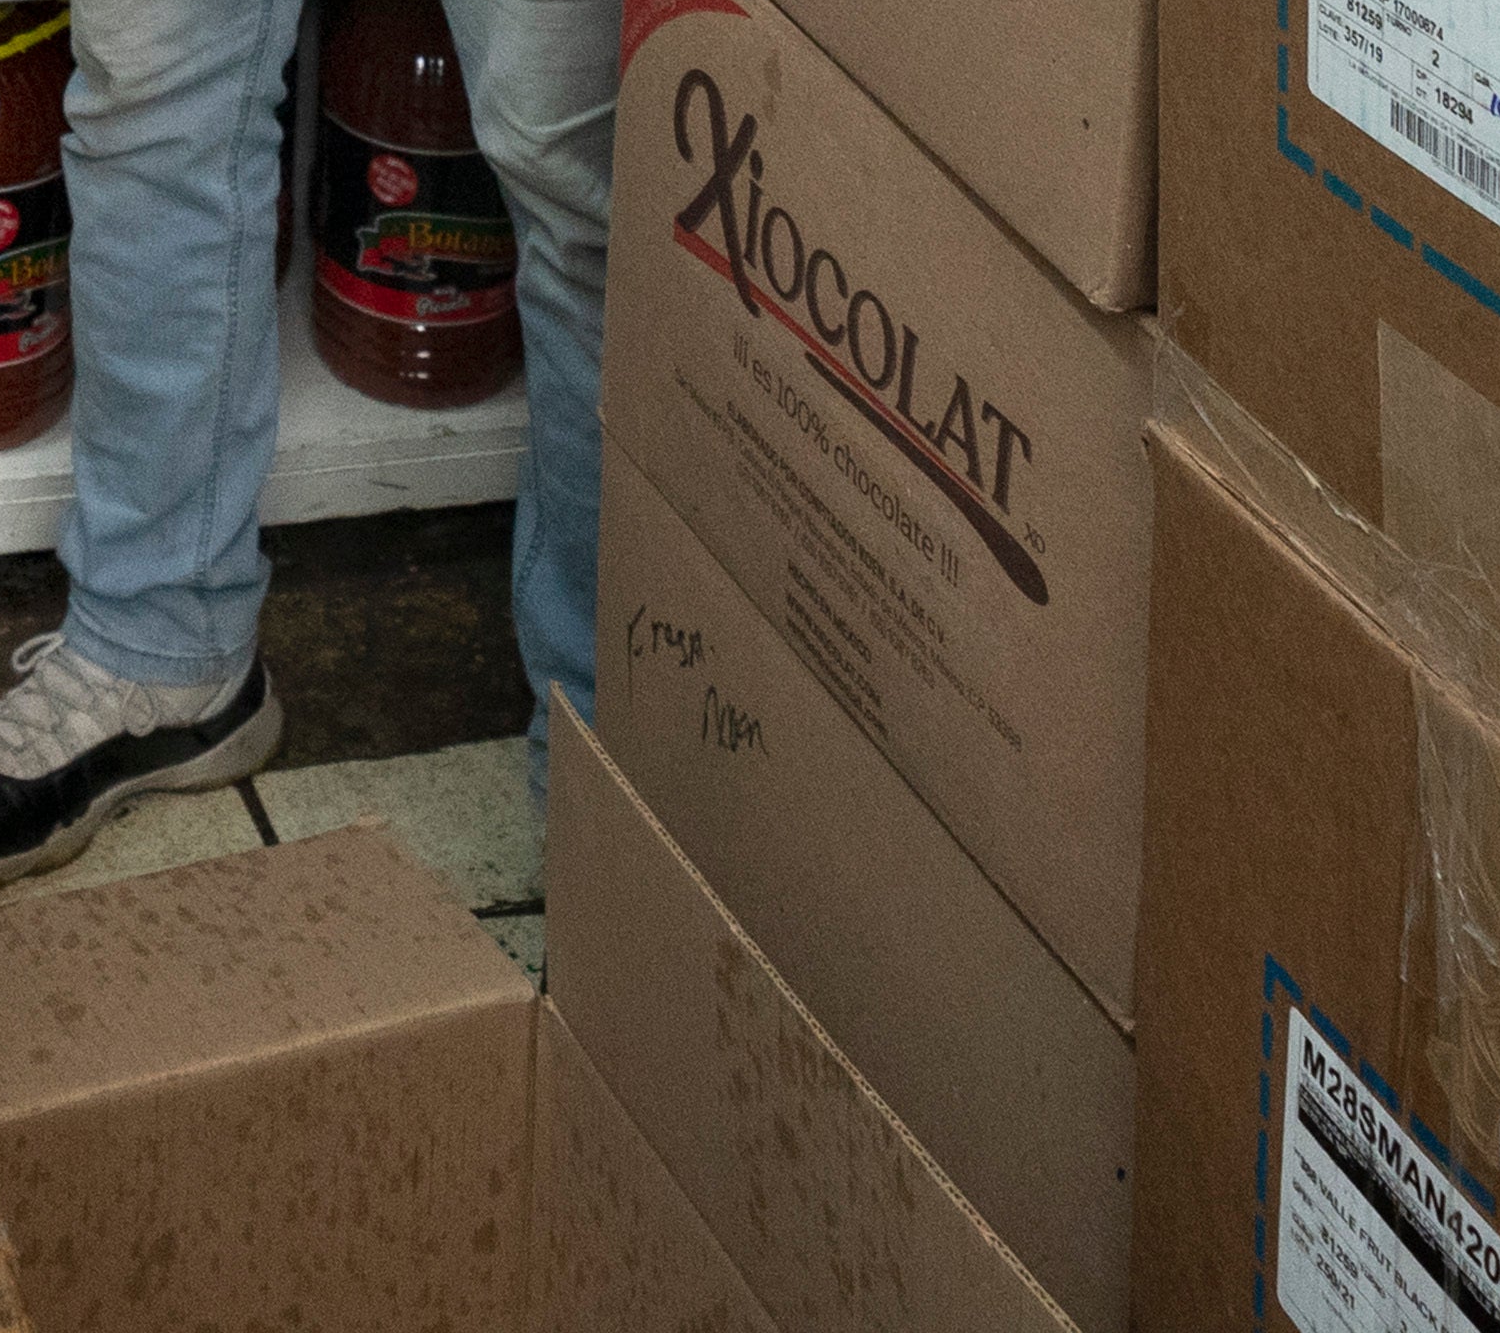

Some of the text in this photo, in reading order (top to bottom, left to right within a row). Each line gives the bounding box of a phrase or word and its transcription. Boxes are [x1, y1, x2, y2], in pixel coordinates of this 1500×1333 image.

[1343, 22, 1383, 65] 357/19
[1431, 47, 1439, 69] 2
[1435, 85, 1474, 126] 18294
[752, 350, 771, 398] es
[777, 371, 829, 460] 100%
[833, 429, 933, 572] chocolate
[1318, 1177, 1437, 1332] VALLE FRUT BLACK
